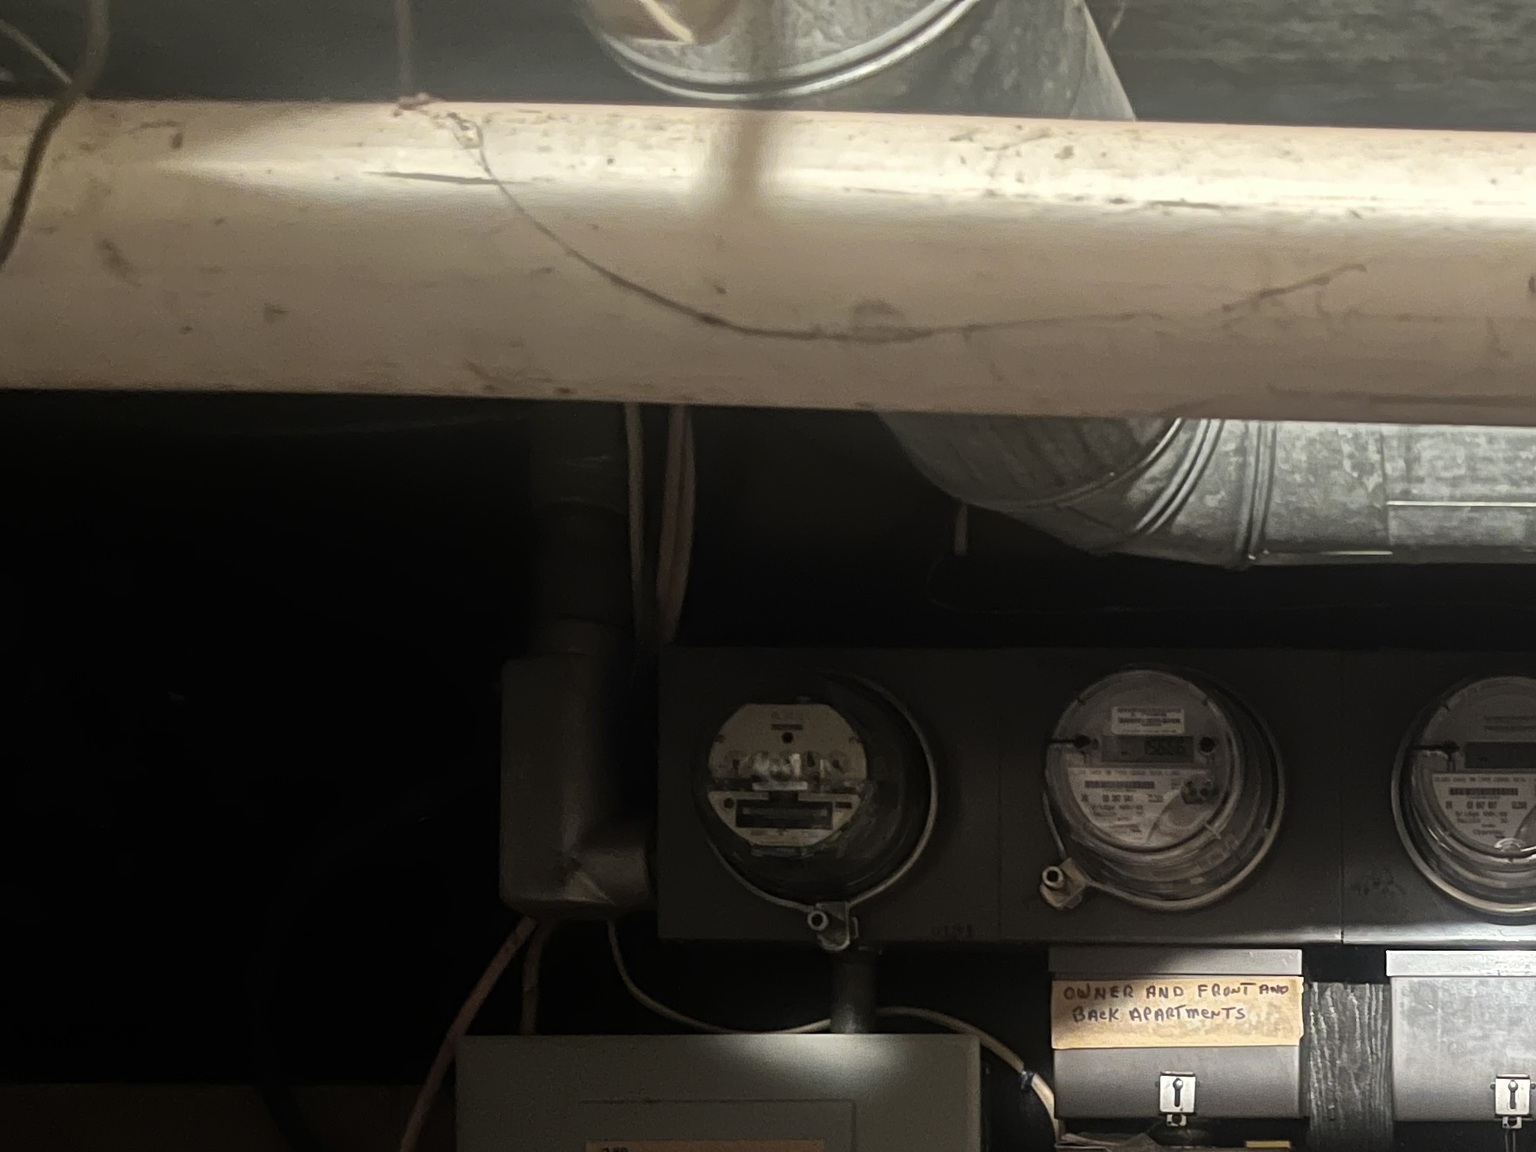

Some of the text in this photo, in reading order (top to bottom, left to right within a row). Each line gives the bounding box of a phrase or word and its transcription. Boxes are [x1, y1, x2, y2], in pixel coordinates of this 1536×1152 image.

[1063, 981, 1290, 1001] OWNER AND FRONT AND
